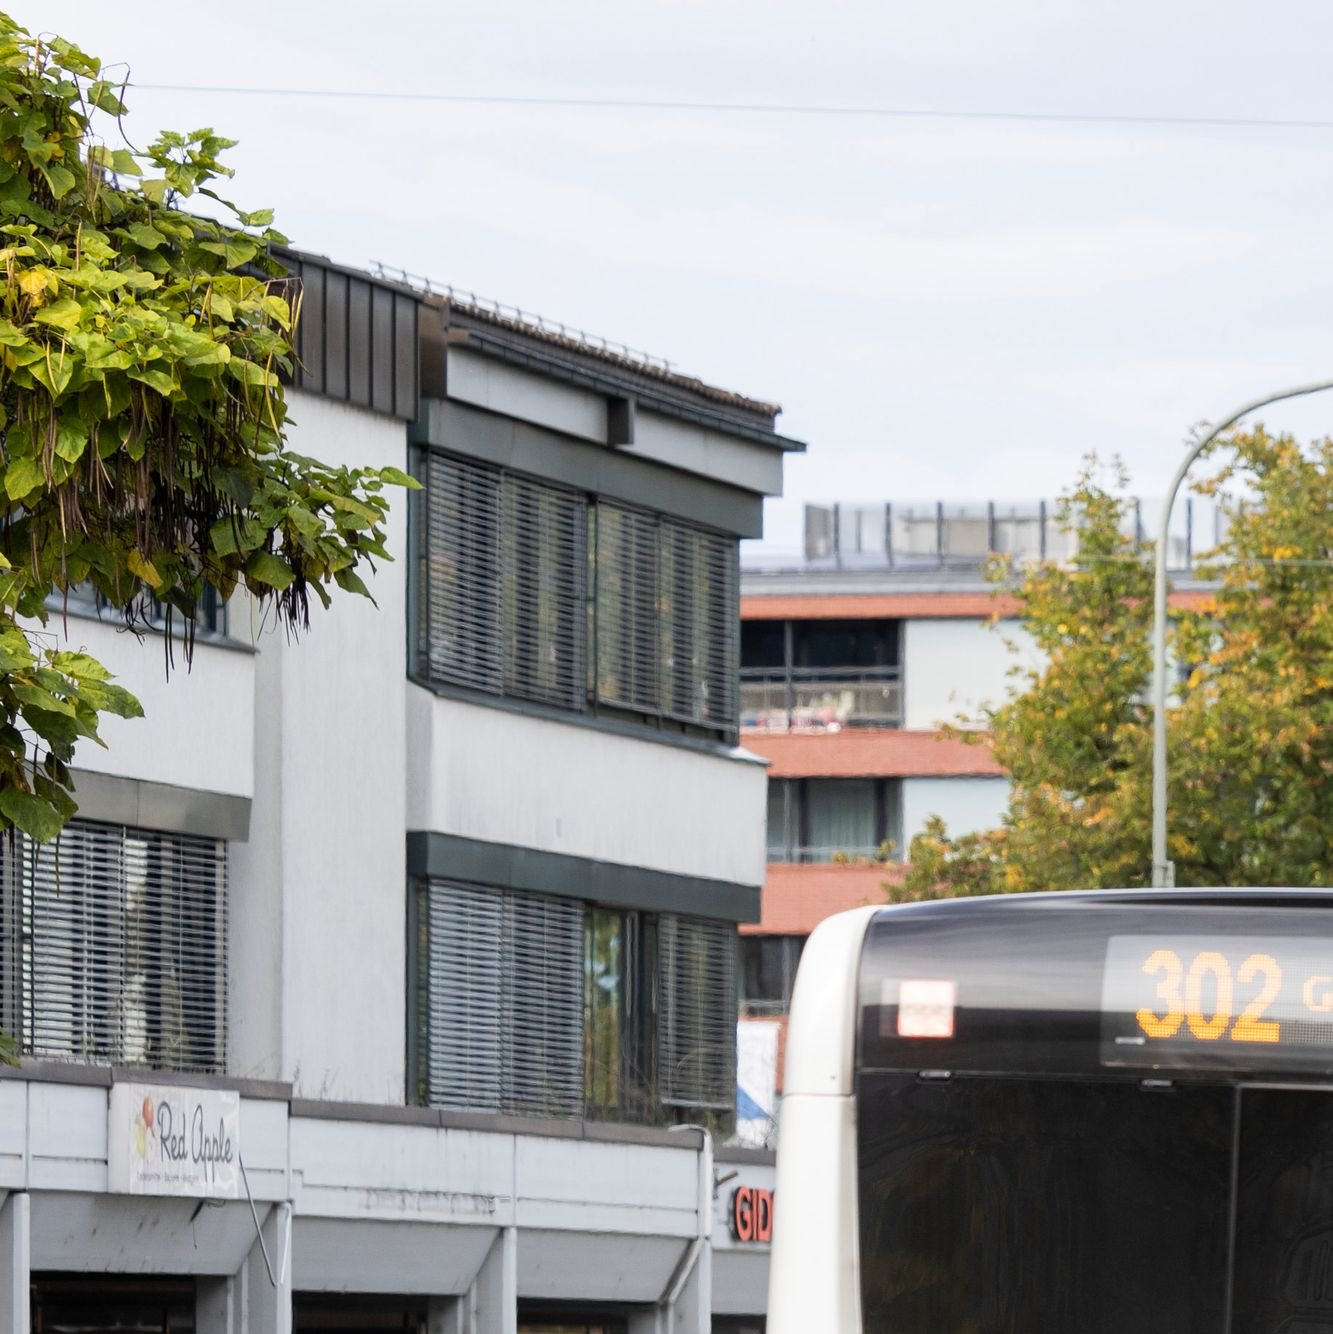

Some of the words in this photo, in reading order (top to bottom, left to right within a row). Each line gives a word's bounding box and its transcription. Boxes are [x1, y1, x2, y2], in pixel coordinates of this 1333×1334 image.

[1136, 949, 1283, 1042] 302
[157, 1101, 188, 1162] Red
[191, 1103, 234, 1184] Apple
[735, 1185, 776, 1241] GID
